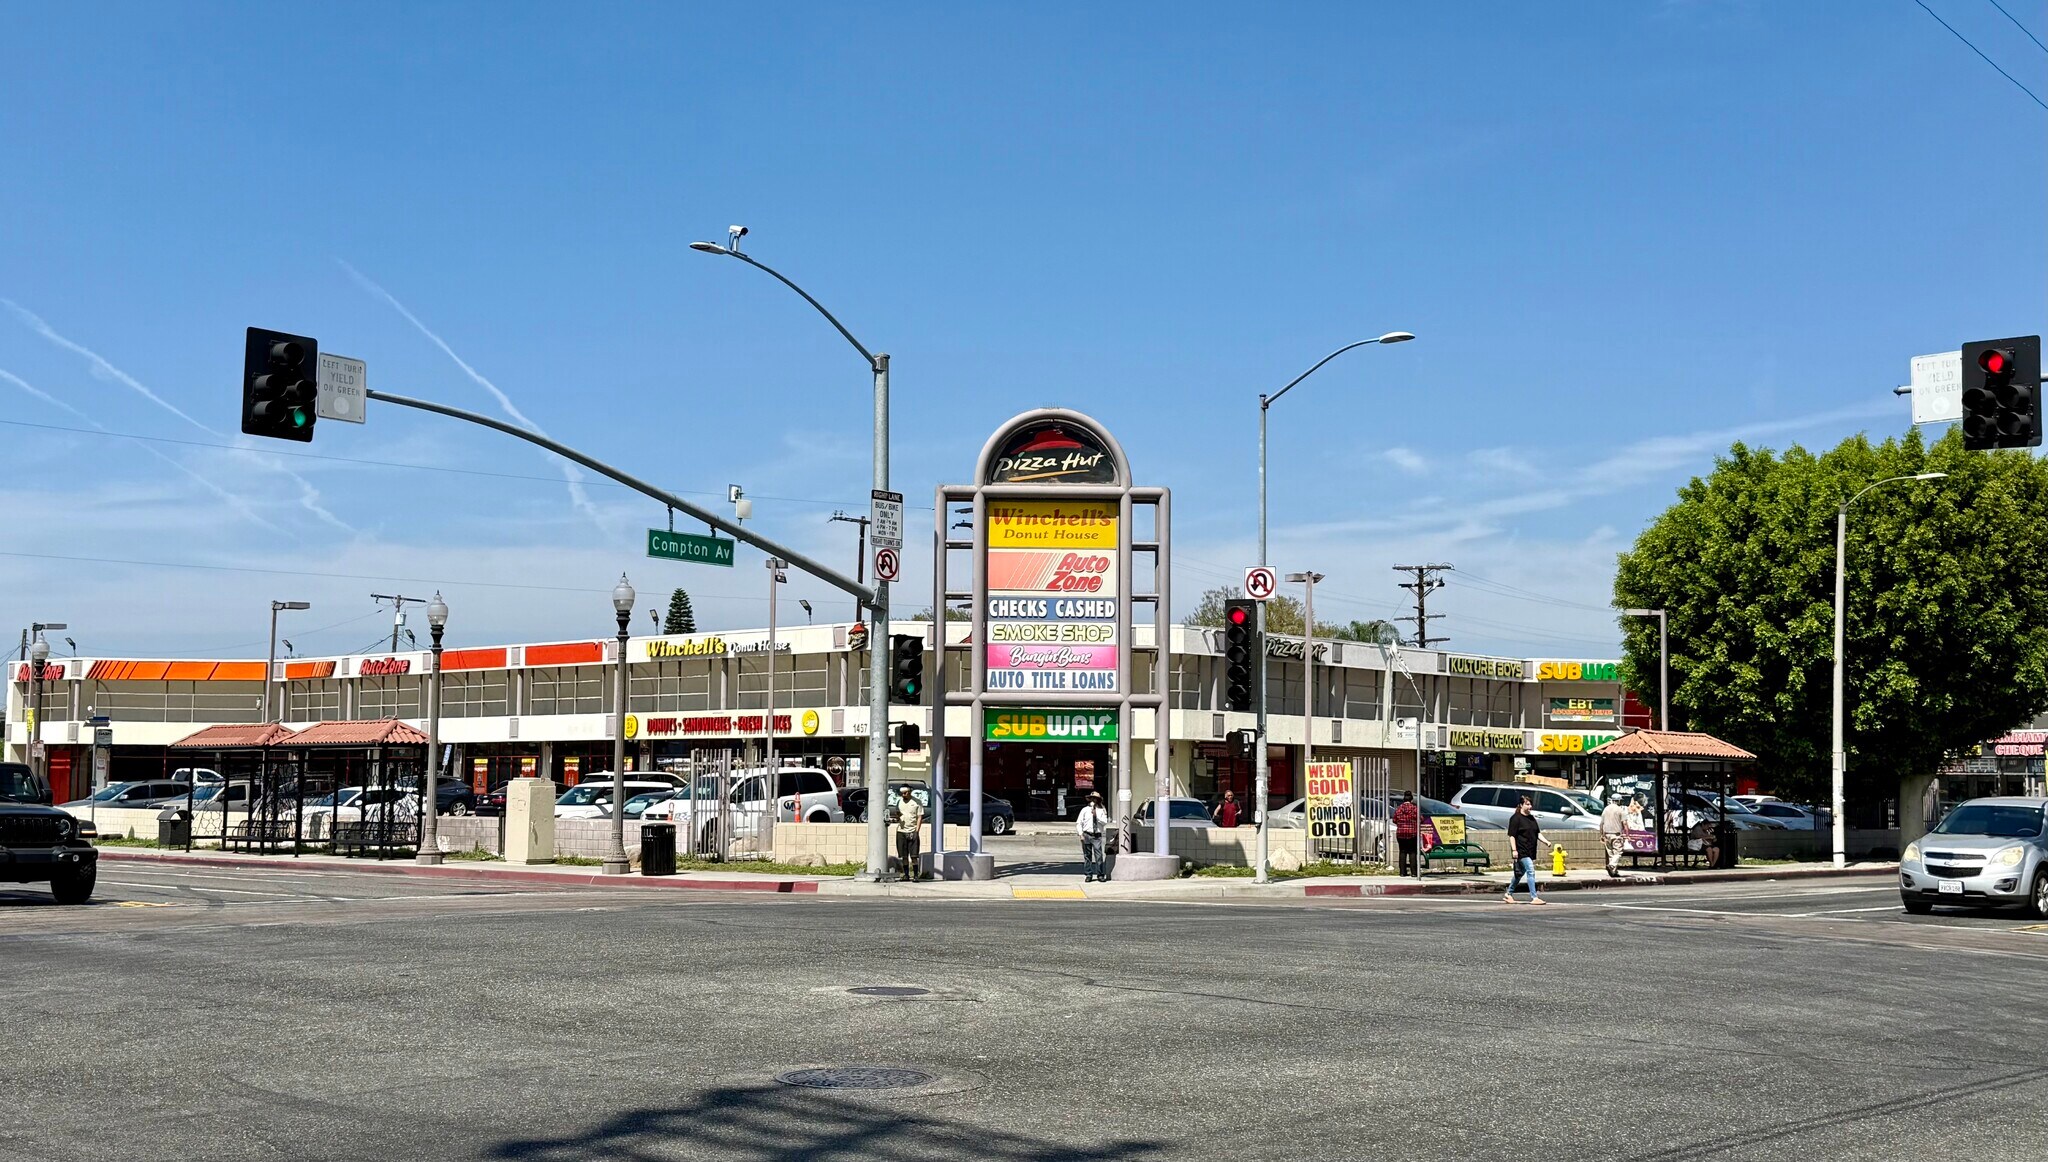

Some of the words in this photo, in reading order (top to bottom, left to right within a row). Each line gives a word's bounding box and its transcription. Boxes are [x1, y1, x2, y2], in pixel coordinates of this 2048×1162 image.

[322, 359, 340, 369] LEFT
[343, 363, 363, 374] TURN
[330, 371, 355, 385] YIELD
[323, 383, 334, 392] ON
[337, 385, 361, 397] GREEN
[1934, 383, 1962, 393] GREEN
[1058, 452, 1105, 471] Hut
[889, 494, 901, 502] LANE
[880, 511, 894, 519] ONLY
[992, 507, 1112, 528] Winchell's
[1003, 528, 1049, 539] Donut
[1053, 529, 1100, 540] House
[652, 535, 709, 557] Compton
[715, 544, 730, 559] Av
[1056, 552, 1111, 574] Auto
[1045, 571, 1104, 592] Zone
[988, 599, 1048, 619] CHECKS
[1055, 599, 1116, 619] CASHED
[992, 623, 1059, 642] SMOKE
[1061, 624, 1114, 643] SHOP
[646, 637, 728, 658] Winchell's
[1265, 637, 1300, 658] Pizza
[358, 656, 411, 676] AutoZone
[1449, 657, 1494, 676] KULTURE
[1495, 661, 1523, 678] BOYS
[1537, 662, 1619, 681] SUBWA
[988, 671, 1025, 689] AUTO
[1031, 671, 1066, 689] TITLE
[1072, 671, 1114, 690] LOANS
[1568, 698, 1595, 710] EBT
[647, 717, 677, 734] DONUTS
[682, 716, 731, 733] SANDWICHES
[738, 715, 763, 733] FRESH
[853, 723, 868, 733] 1457
[992, 713, 1113, 737] SUBWAY
[1450, 730, 1484, 748] MARKET
[1489, 733, 1524, 749] TOBACCO
[1308, 764, 1324, 778] WE
[1326, 764, 1346, 778] BUY
[1308, 779, 1349, 795] GOLD
[1309, 805, 1352, 821] COMPRO
[1311, 821, 1351, 837] ORO
